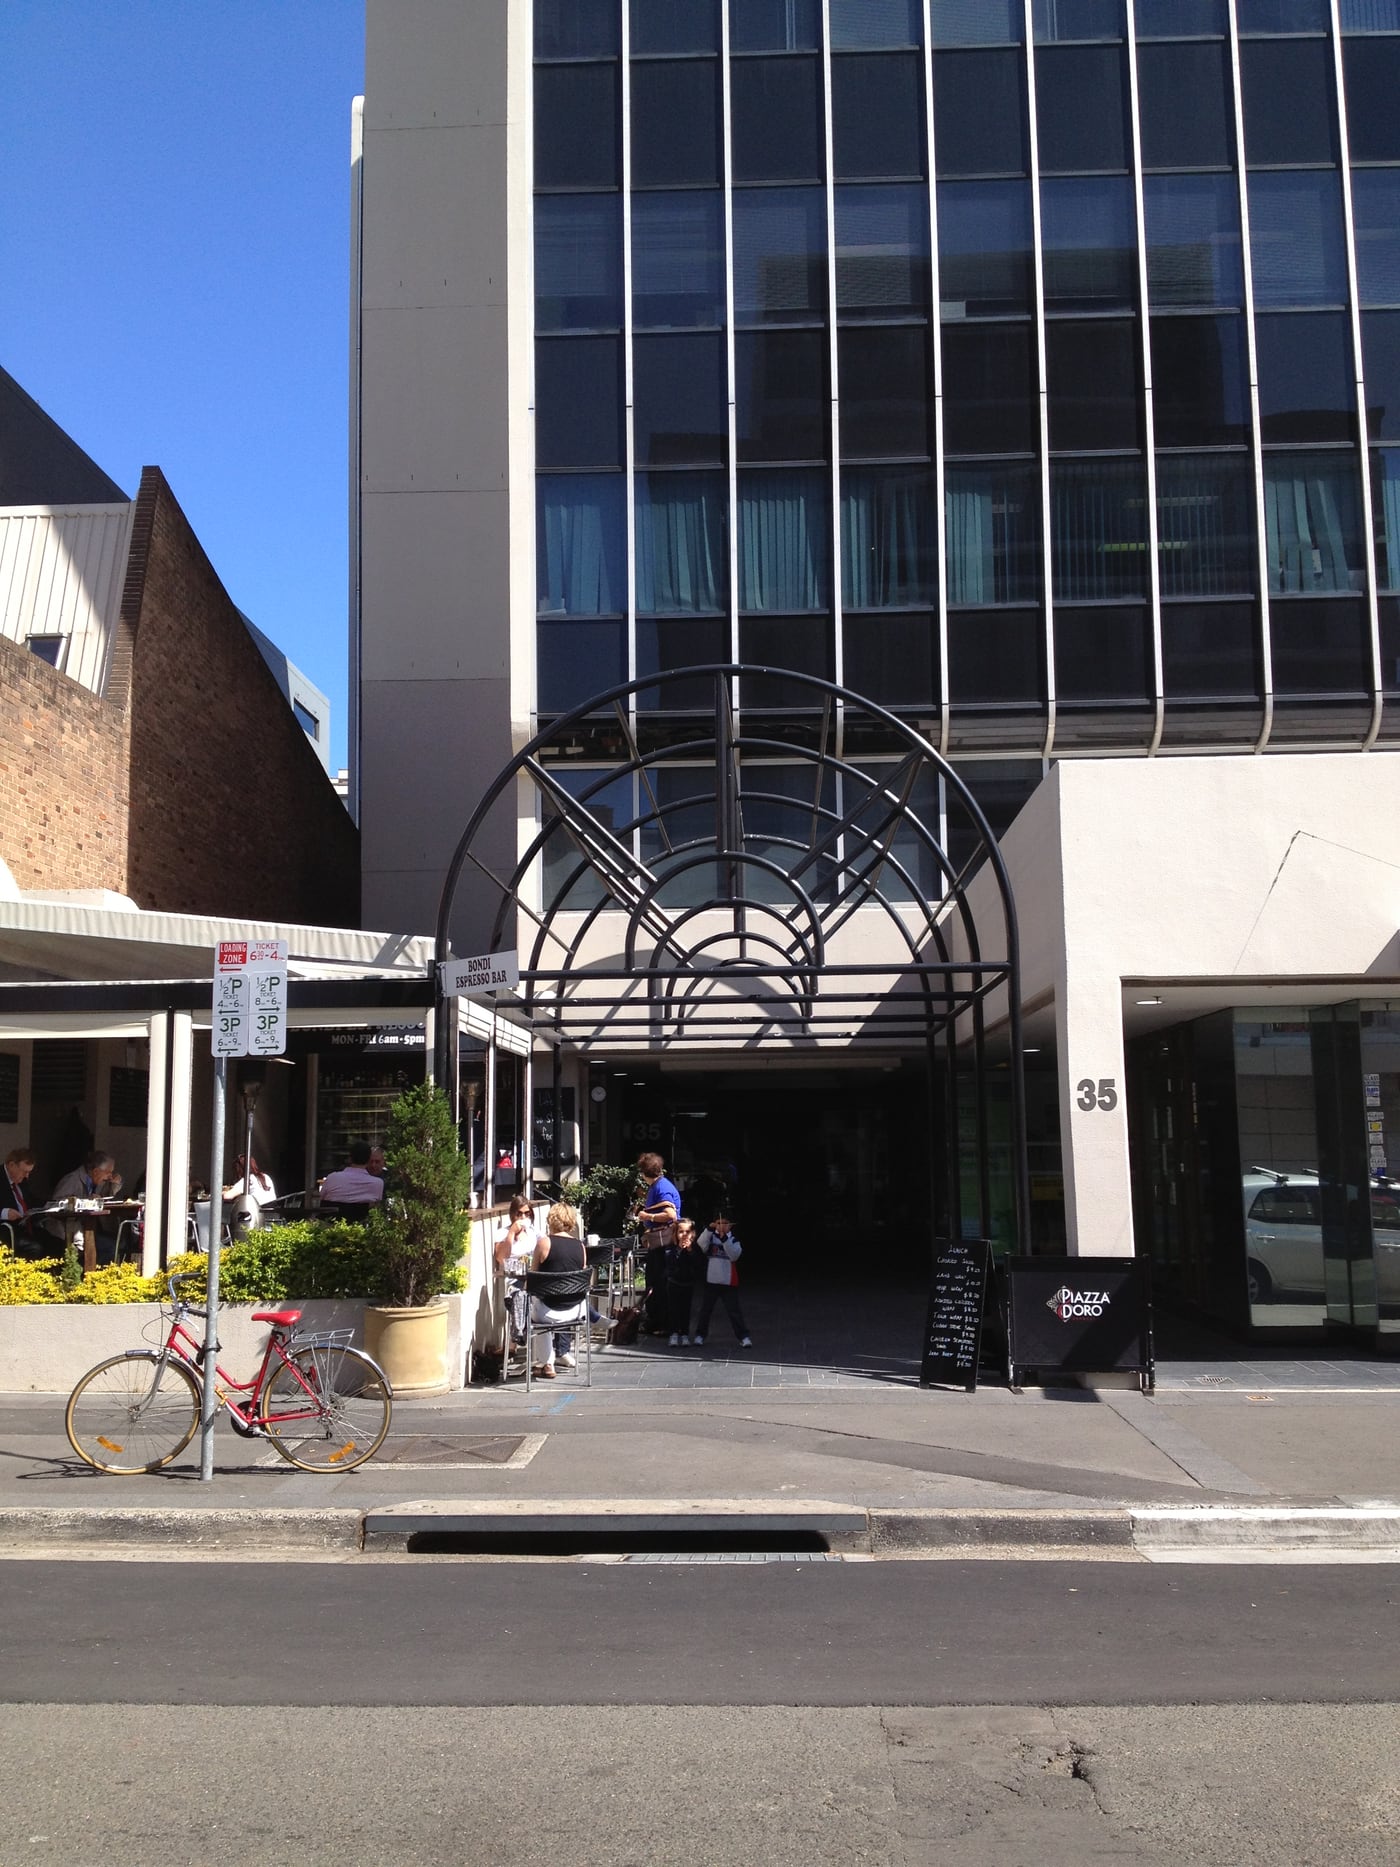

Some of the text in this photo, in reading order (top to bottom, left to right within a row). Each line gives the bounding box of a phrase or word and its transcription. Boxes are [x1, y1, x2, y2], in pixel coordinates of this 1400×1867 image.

[220, 943, 247, 952] LOADING
[255, 942, 279, 950] TICKET
[222, 954, 243, 964] ZONE
[467, 957, 491, 973] BONDI
[455, 970, 508, 989] ESPRESSO BAR
[219, 1017, 241, 1033] 3P
[256, 1014, 279, 1031] 3P
[1077, 1078, 1118, 1112] 35
[1062, 1288, 1110, 1304] PIAZZA
[1062, 1304, 1103, 1319] DORO
